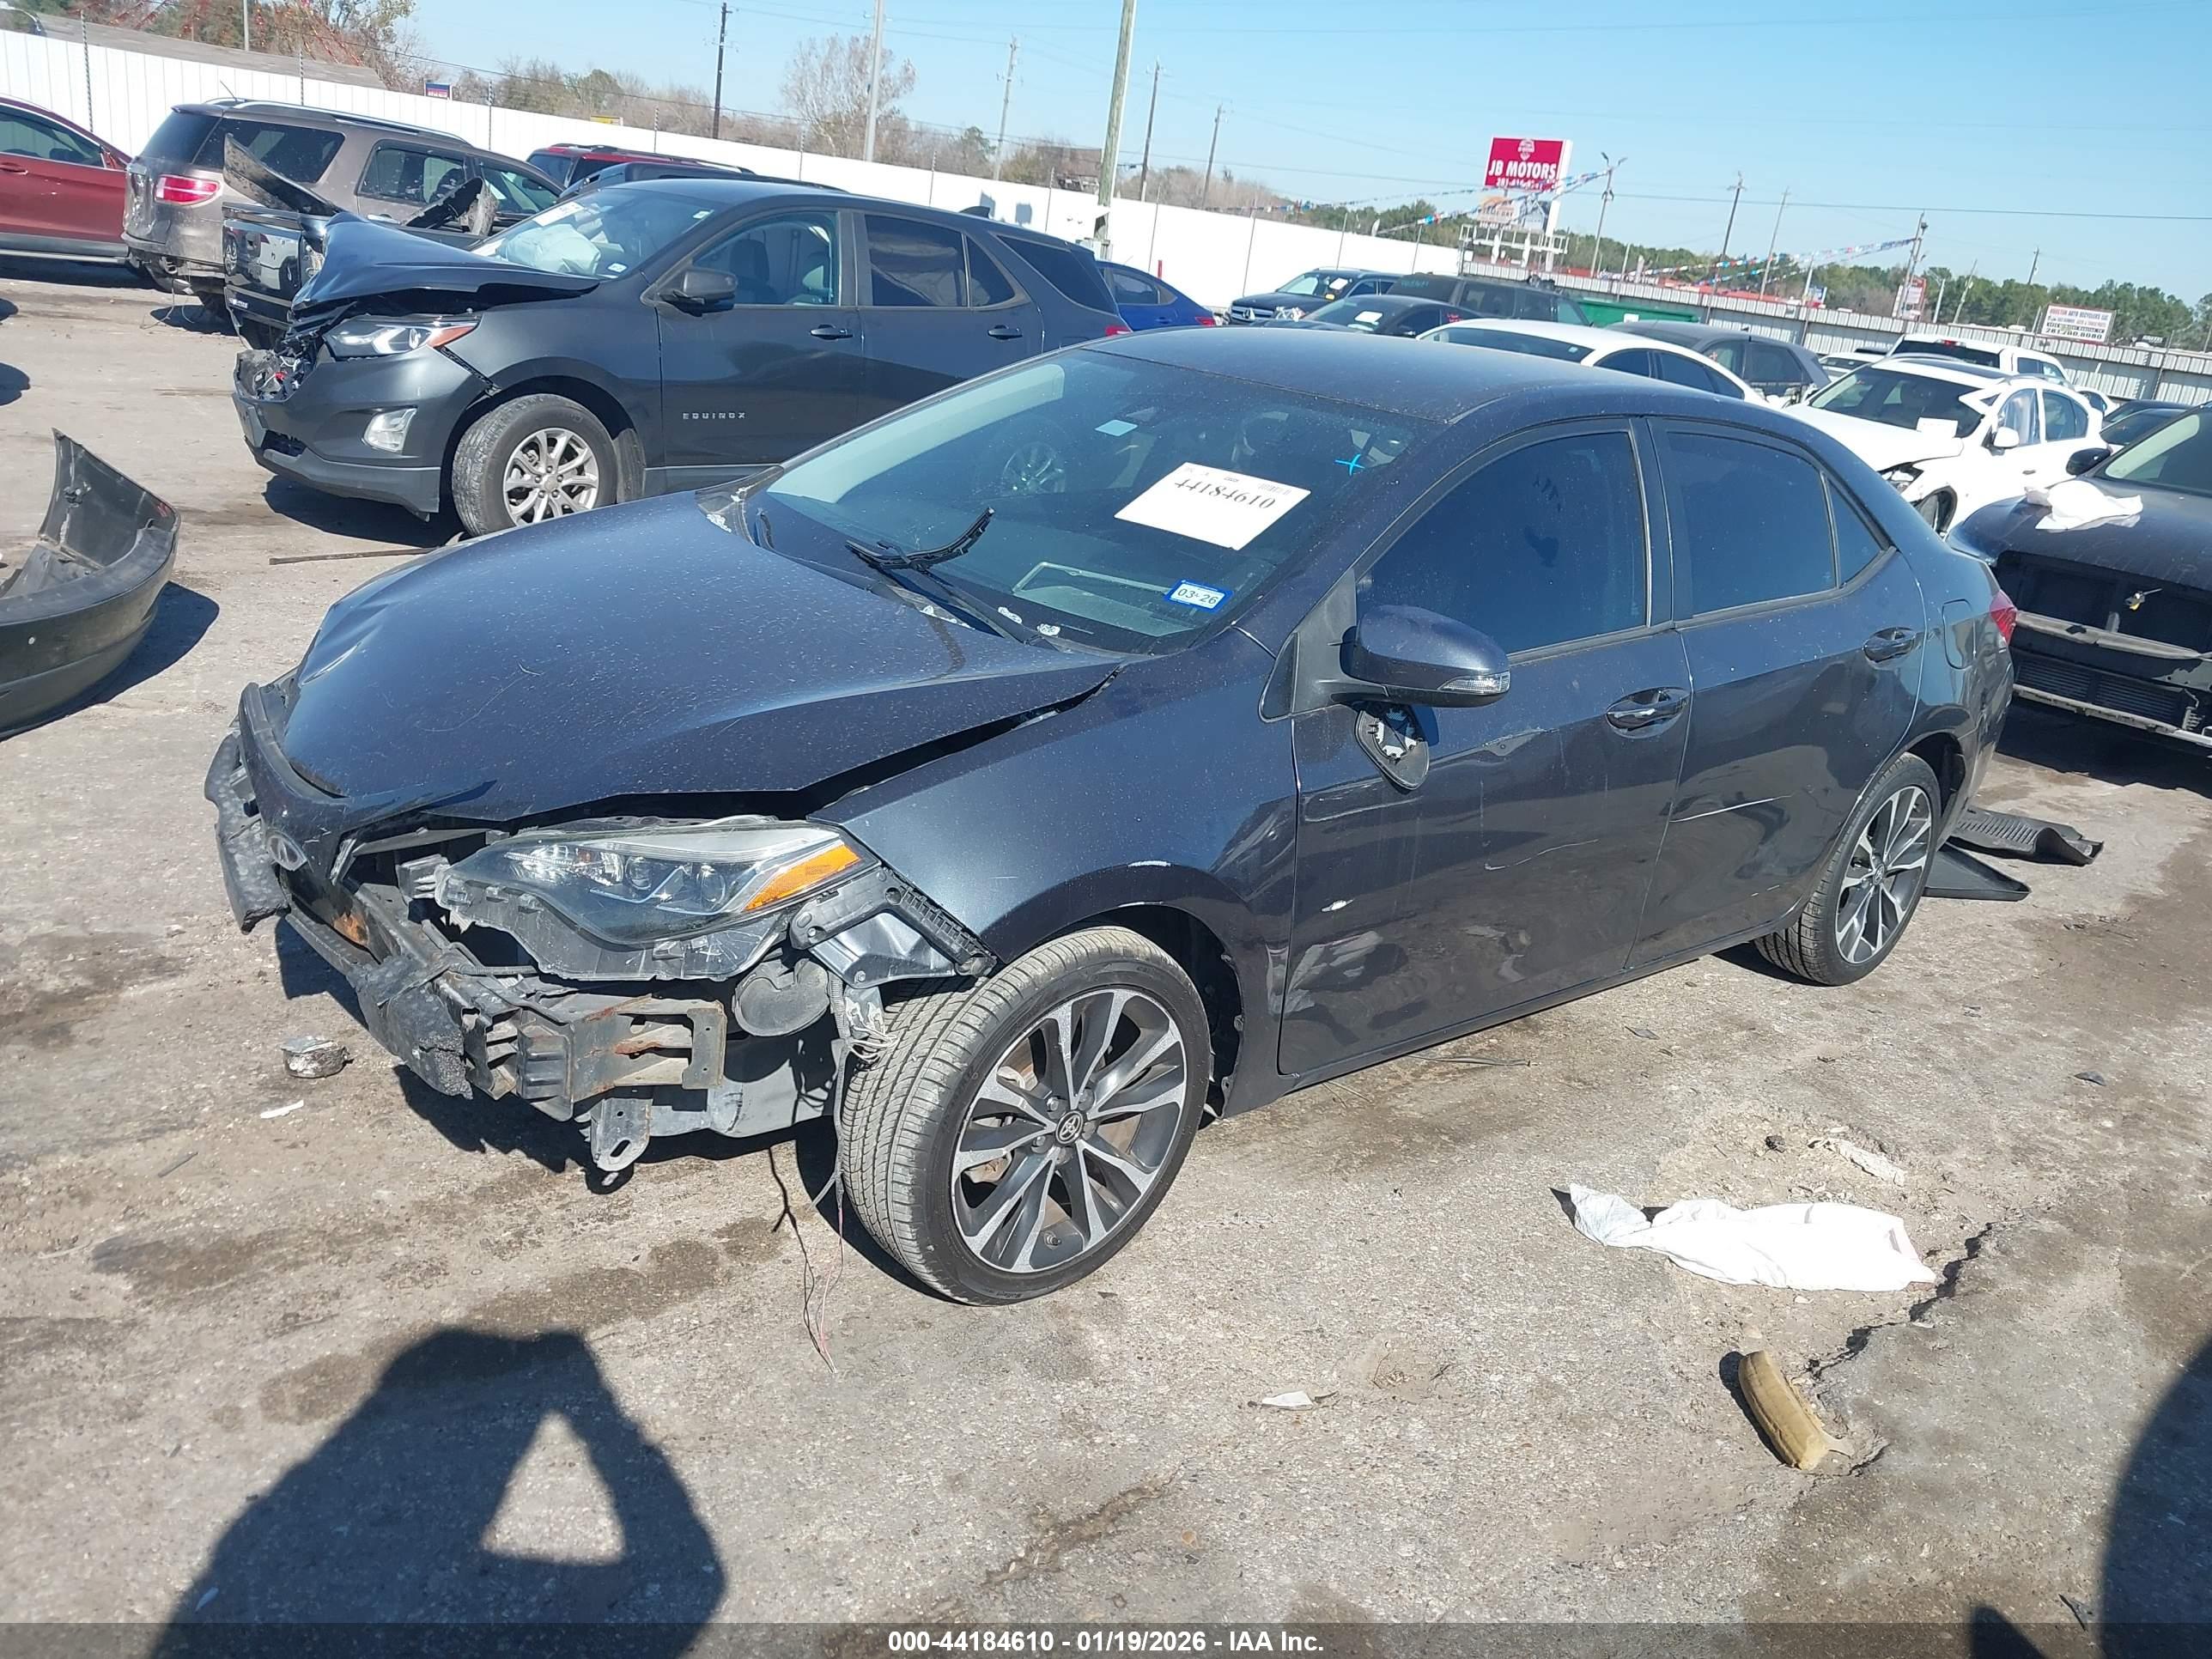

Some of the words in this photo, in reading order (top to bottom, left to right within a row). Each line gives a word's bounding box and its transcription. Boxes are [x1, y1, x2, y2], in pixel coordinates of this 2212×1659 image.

[1488, 160, 1504, 176] JB
[1505, 161, 1557, 179] MOTORS
[1174, 478, 1276, 509] 44184610
